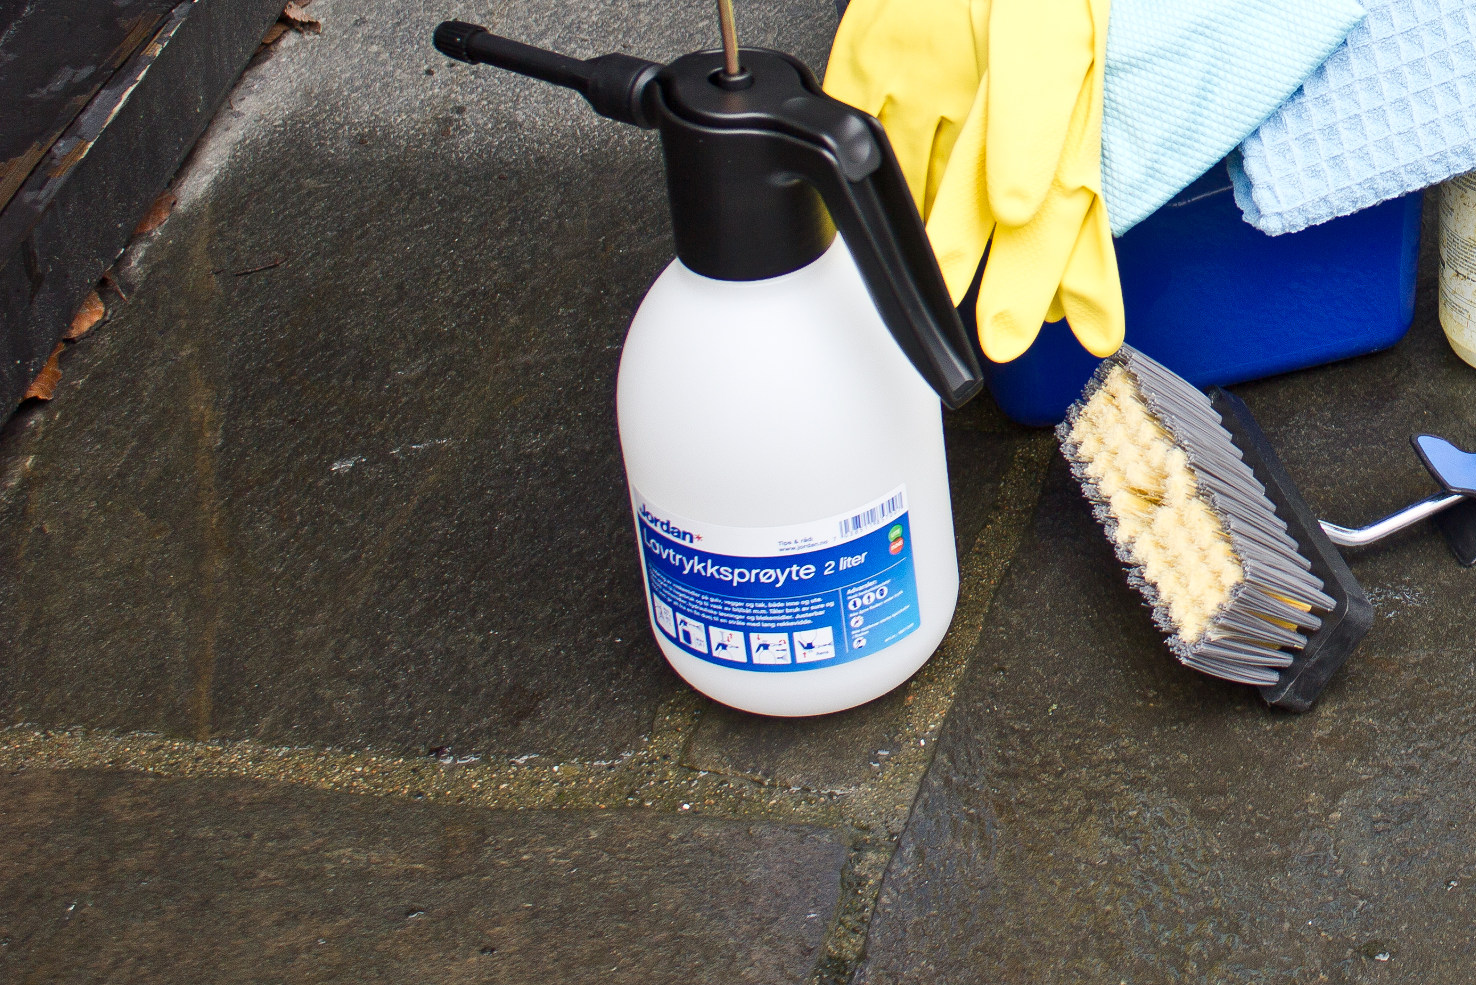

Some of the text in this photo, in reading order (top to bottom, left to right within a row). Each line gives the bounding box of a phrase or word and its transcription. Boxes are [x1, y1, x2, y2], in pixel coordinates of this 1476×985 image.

[639, 503, 694, 544] Jordan
[643, 528, 816, 588] Lavtrykksprøyte
[824, 560, 836, 576] 2
[839, 552, 868, 571] liter
